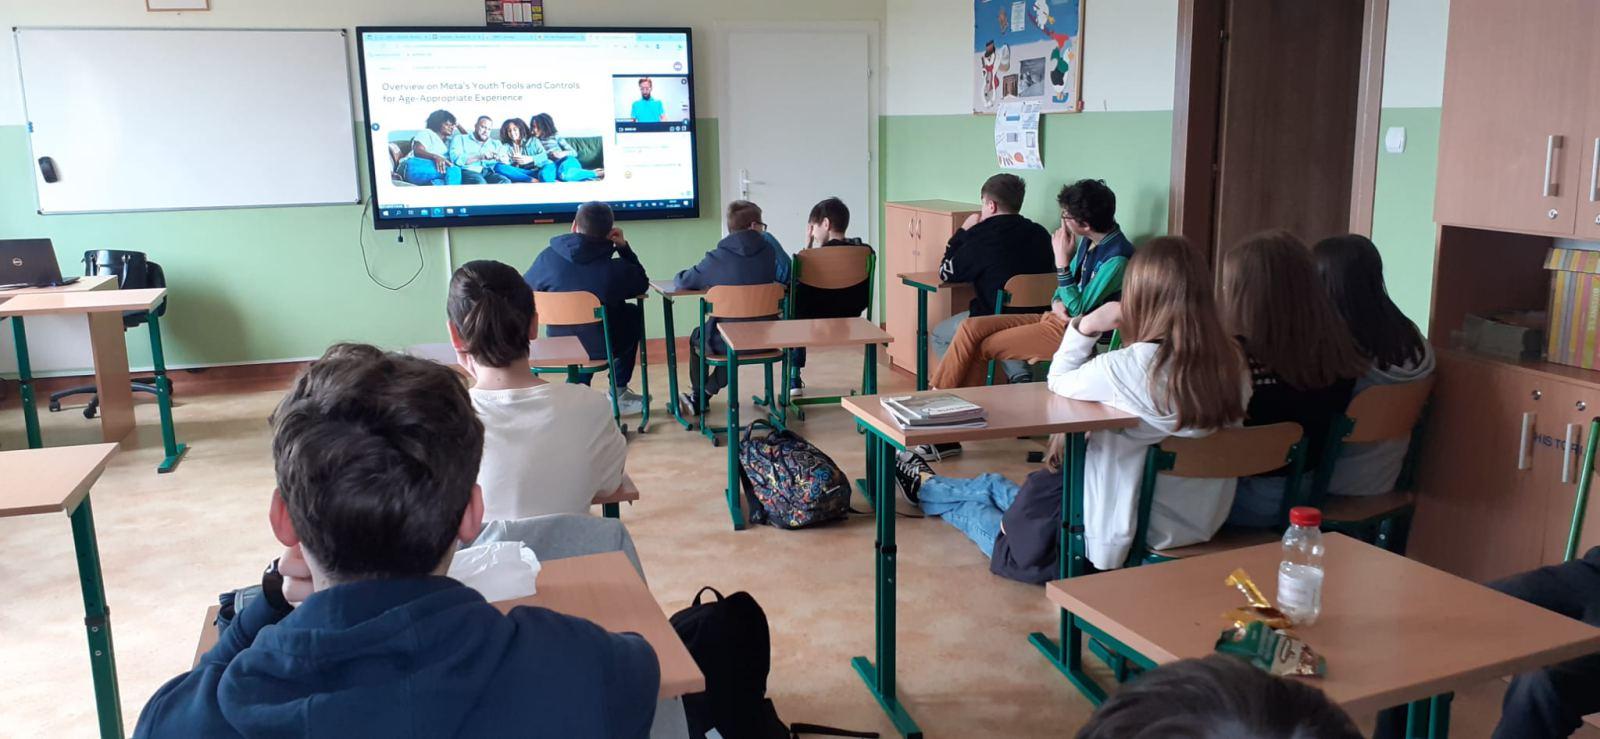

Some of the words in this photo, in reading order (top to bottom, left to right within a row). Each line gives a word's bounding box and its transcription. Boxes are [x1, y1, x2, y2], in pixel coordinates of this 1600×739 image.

[382, 82, 424, 91] Overview
[440, 81, 470, 90] Meta's
[472, 81, 499, 90] Youth
[501, 81, 524, 90] Tools
[526, 81, 542, 90] and
[544, 81, 580, 90] Controls
[383, 94, 395, 103] for
[399, 94, 472, 104] Age-Appropriate
[474, 93, 523, 104] Experience
